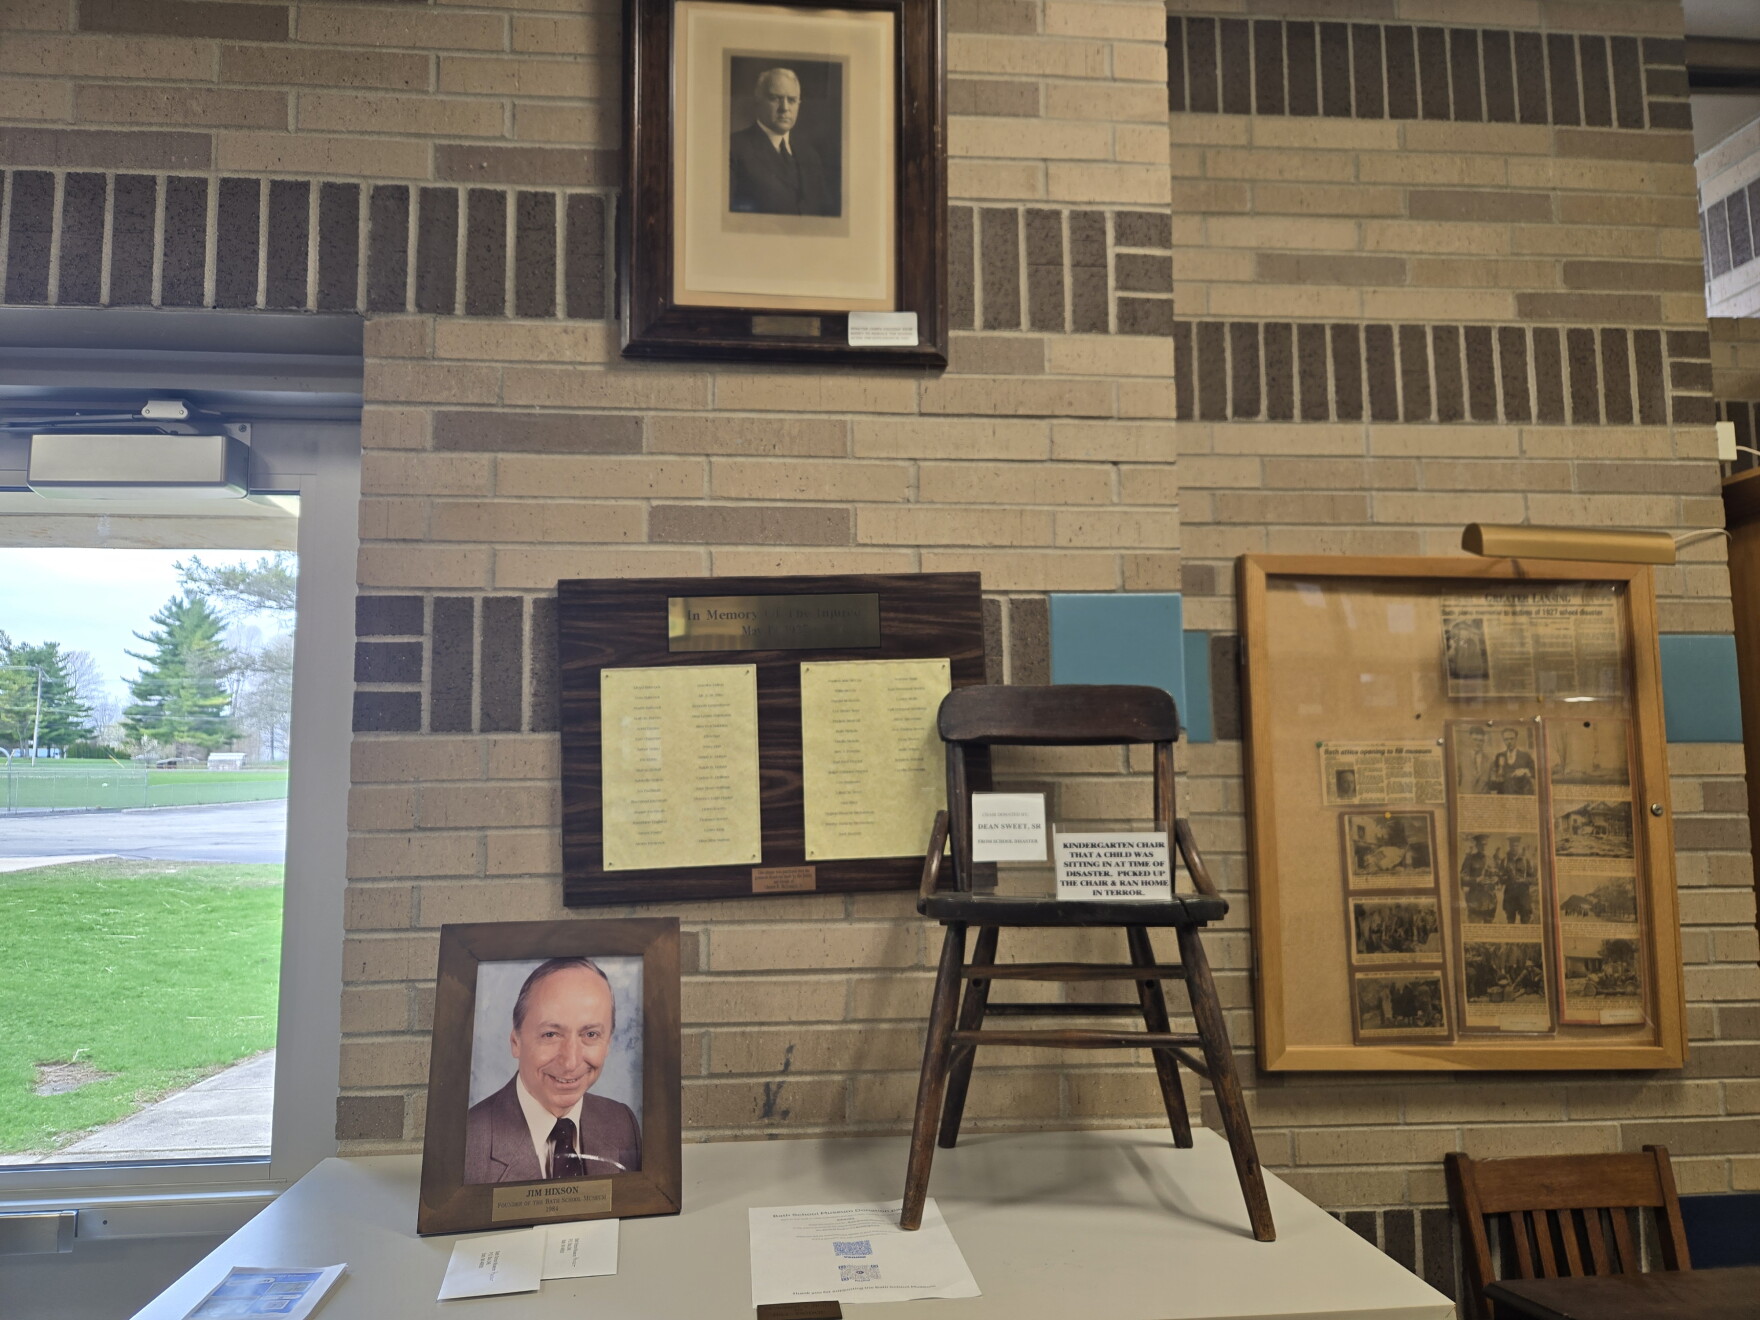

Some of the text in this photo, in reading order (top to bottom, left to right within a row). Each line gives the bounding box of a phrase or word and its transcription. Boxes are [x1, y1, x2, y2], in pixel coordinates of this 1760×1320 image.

[687, 610, 700, 620] In
[706, 608, 758, 622] Memory
[1542, 608, 1558, 616] 1927
[742, 626, 762, 637] May
[1360, 748, 1385, 756] opening
[526, 1186, 579, 1198] JIM HIXSON
